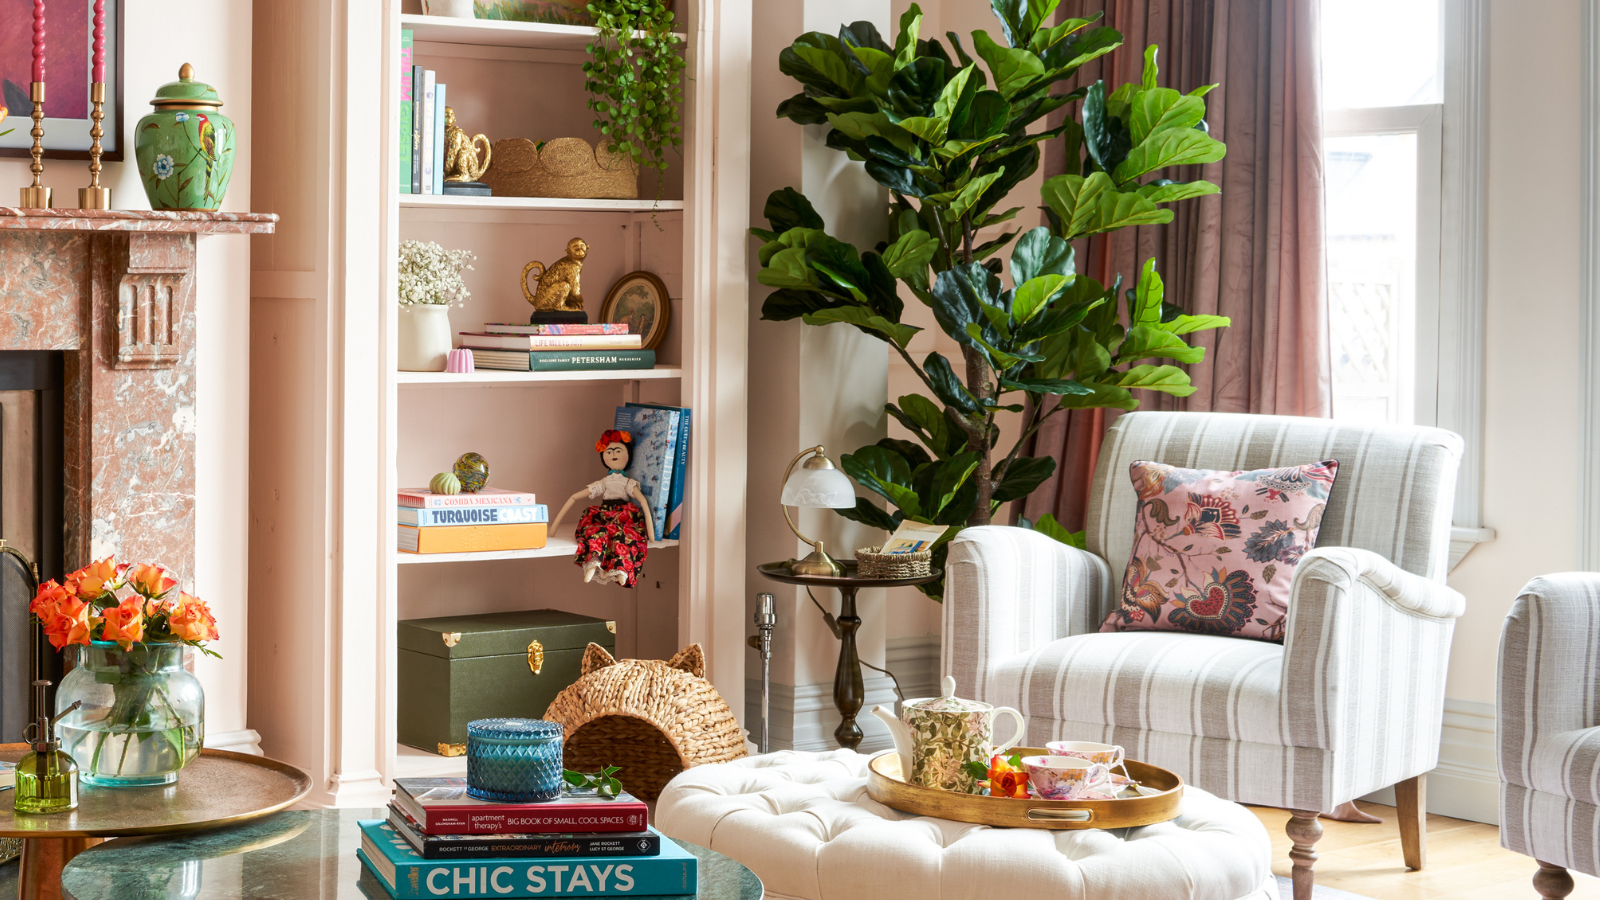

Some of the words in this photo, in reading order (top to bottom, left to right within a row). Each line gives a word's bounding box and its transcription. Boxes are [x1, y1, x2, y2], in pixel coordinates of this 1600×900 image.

[571, 356, 617, 364] PETERSHAM
[662, 456, 674, 491] LIDO
[444, 498, 473, 506] COMIDA
[475, 497, 513, 505] MEXICANA
[432, 508, 498, 524] TURQUOISE
[499, 507, 538, 522] COAST
[474, 822, 502, 830] therapy's
[554, 817, 577, 825] SMALL,
[600, 816, 624, 824] SPACES
[544, 840, 581, 854] interiors
[426, 866, 514, 895] CHIC
[526, 864, 635, 893] STAYS
